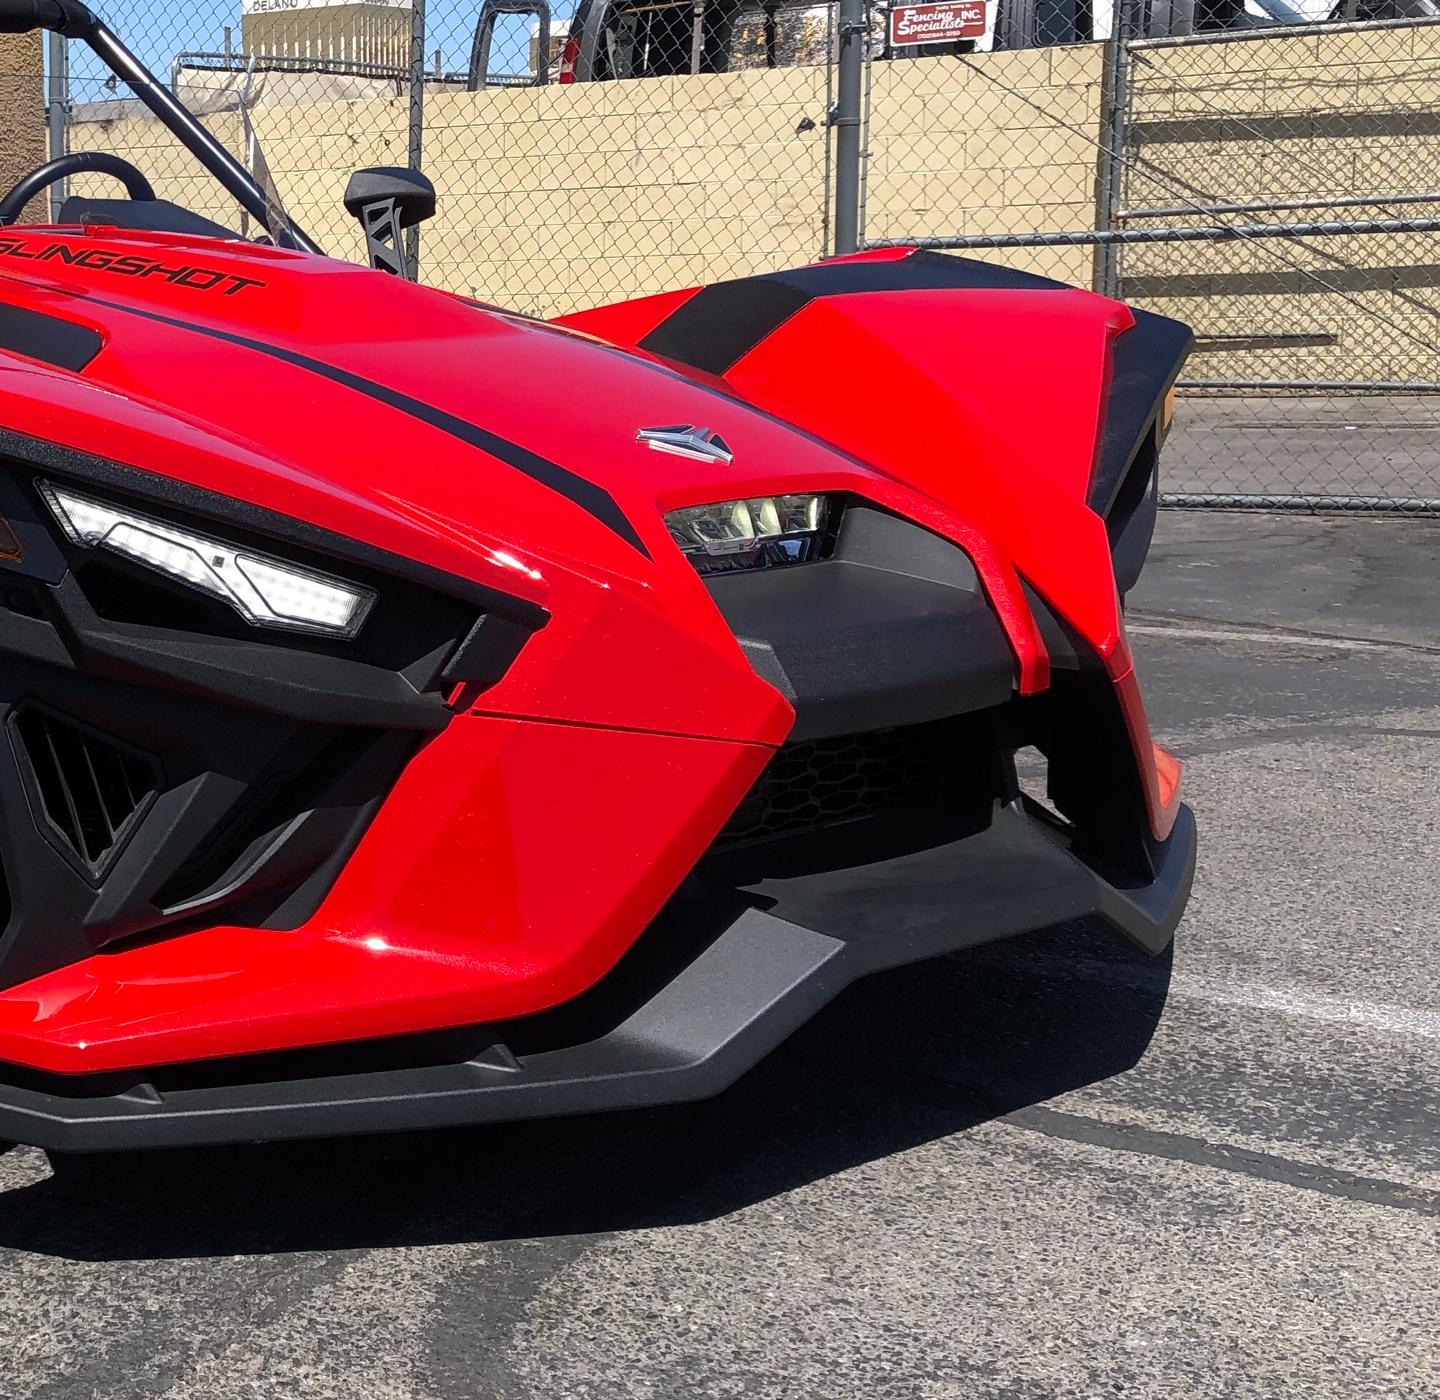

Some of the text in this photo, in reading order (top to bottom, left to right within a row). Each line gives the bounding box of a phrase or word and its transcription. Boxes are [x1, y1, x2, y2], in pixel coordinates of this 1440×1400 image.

[903, 10, 982, 22] Fencing INC.
[897, 18, 965, 36] Specialists
